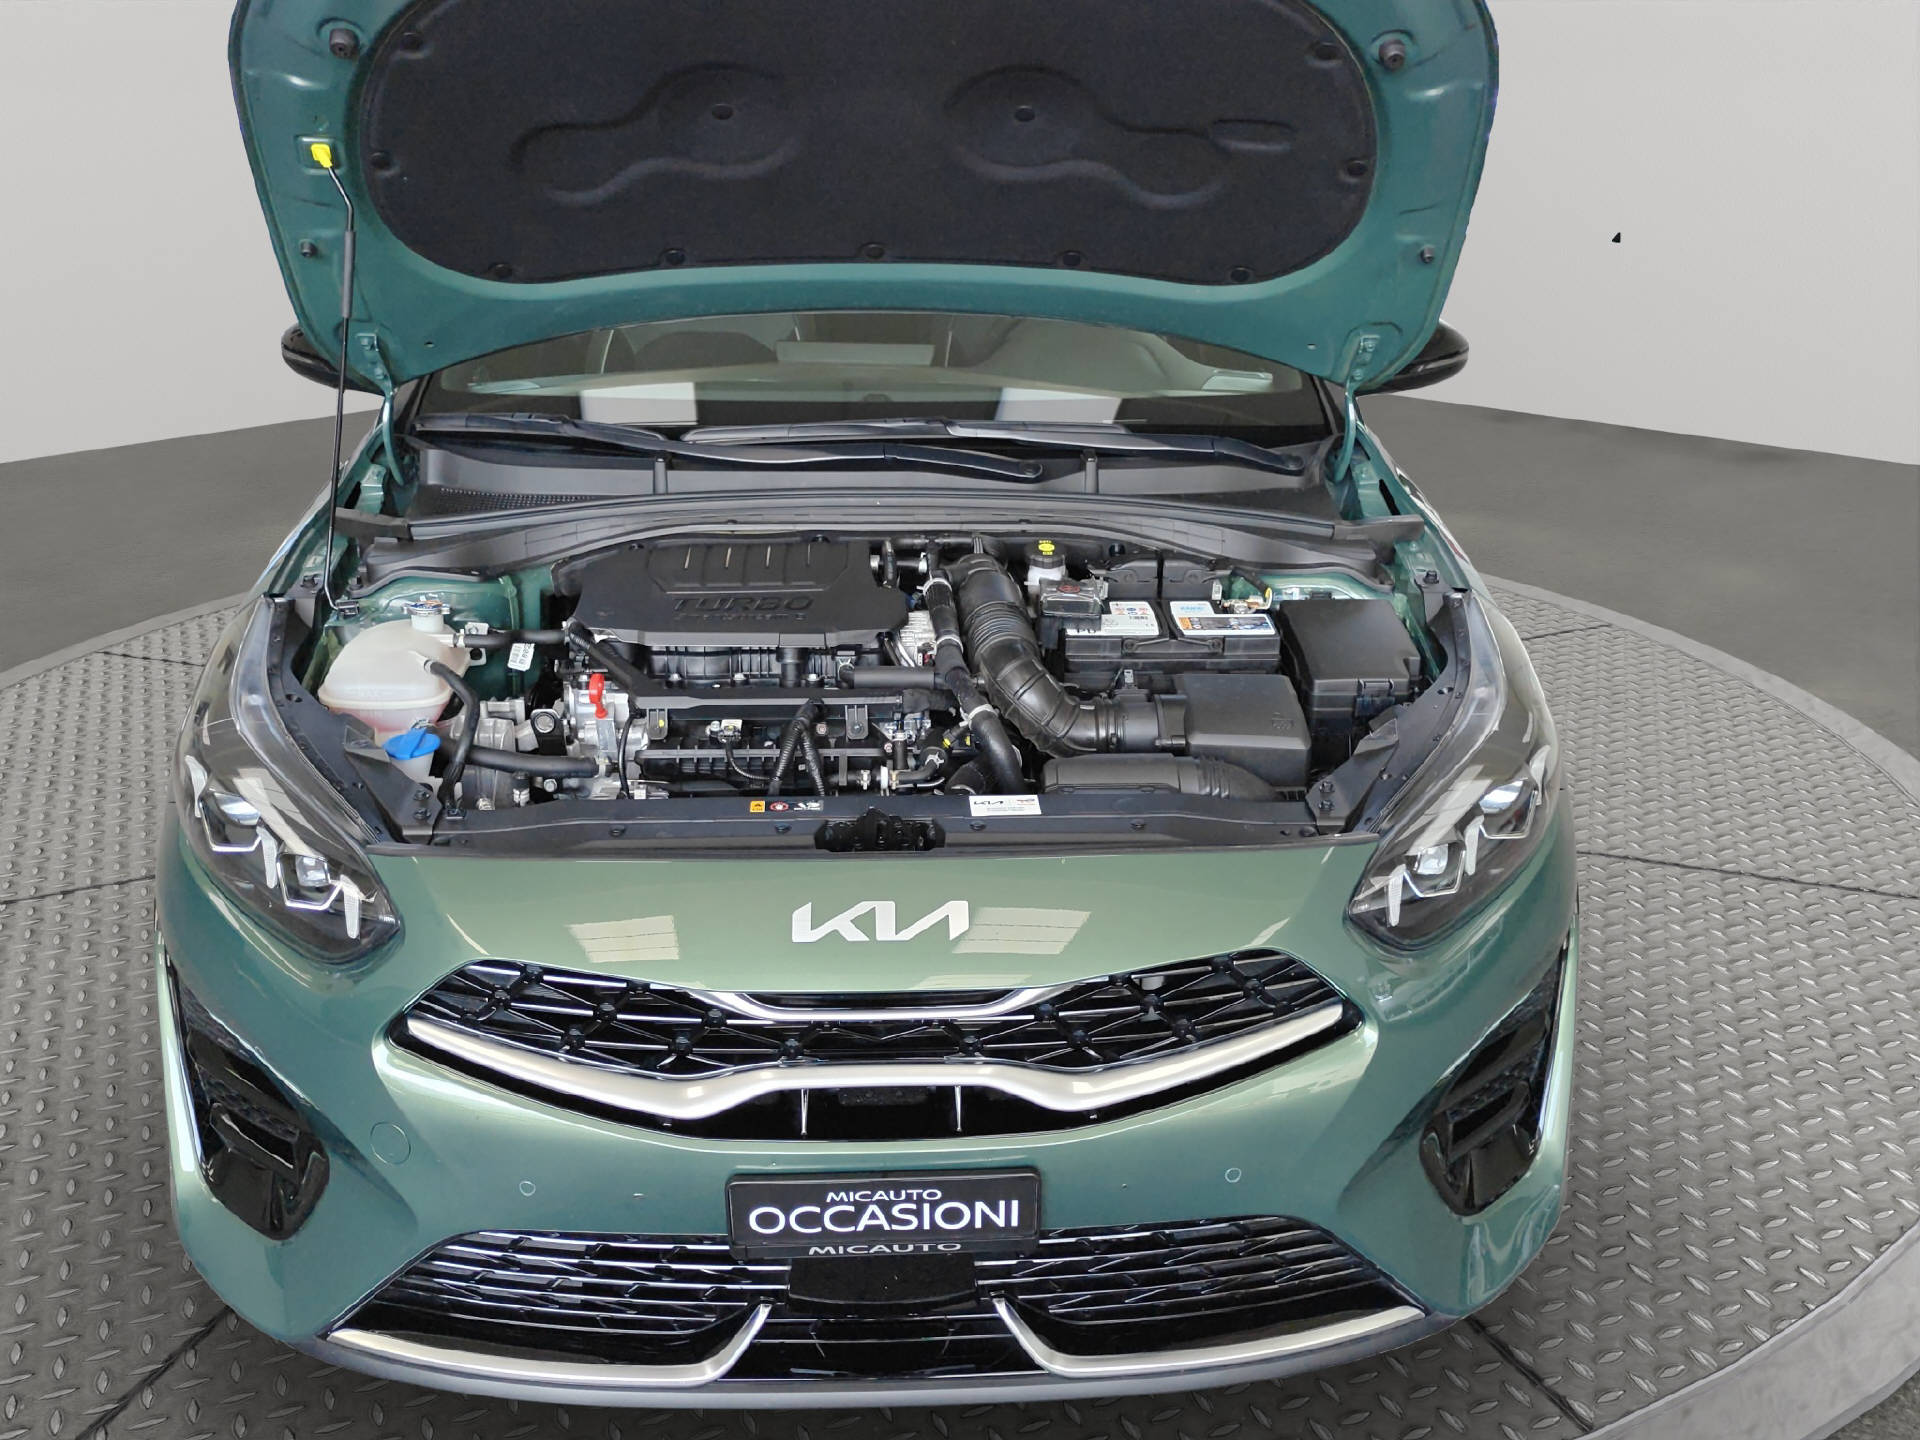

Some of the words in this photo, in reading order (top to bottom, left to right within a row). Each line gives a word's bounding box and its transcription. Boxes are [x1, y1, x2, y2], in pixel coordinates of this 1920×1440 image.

[673, 597, 814, 611] TURBO
[792, 900, 969, 942] KIA
[826, 1189, 942, 1202] MICAUTO
[748, 1200, 1019, 1234] OCCASIONI
[808, 1243, 962, 1256] MICAUTO
